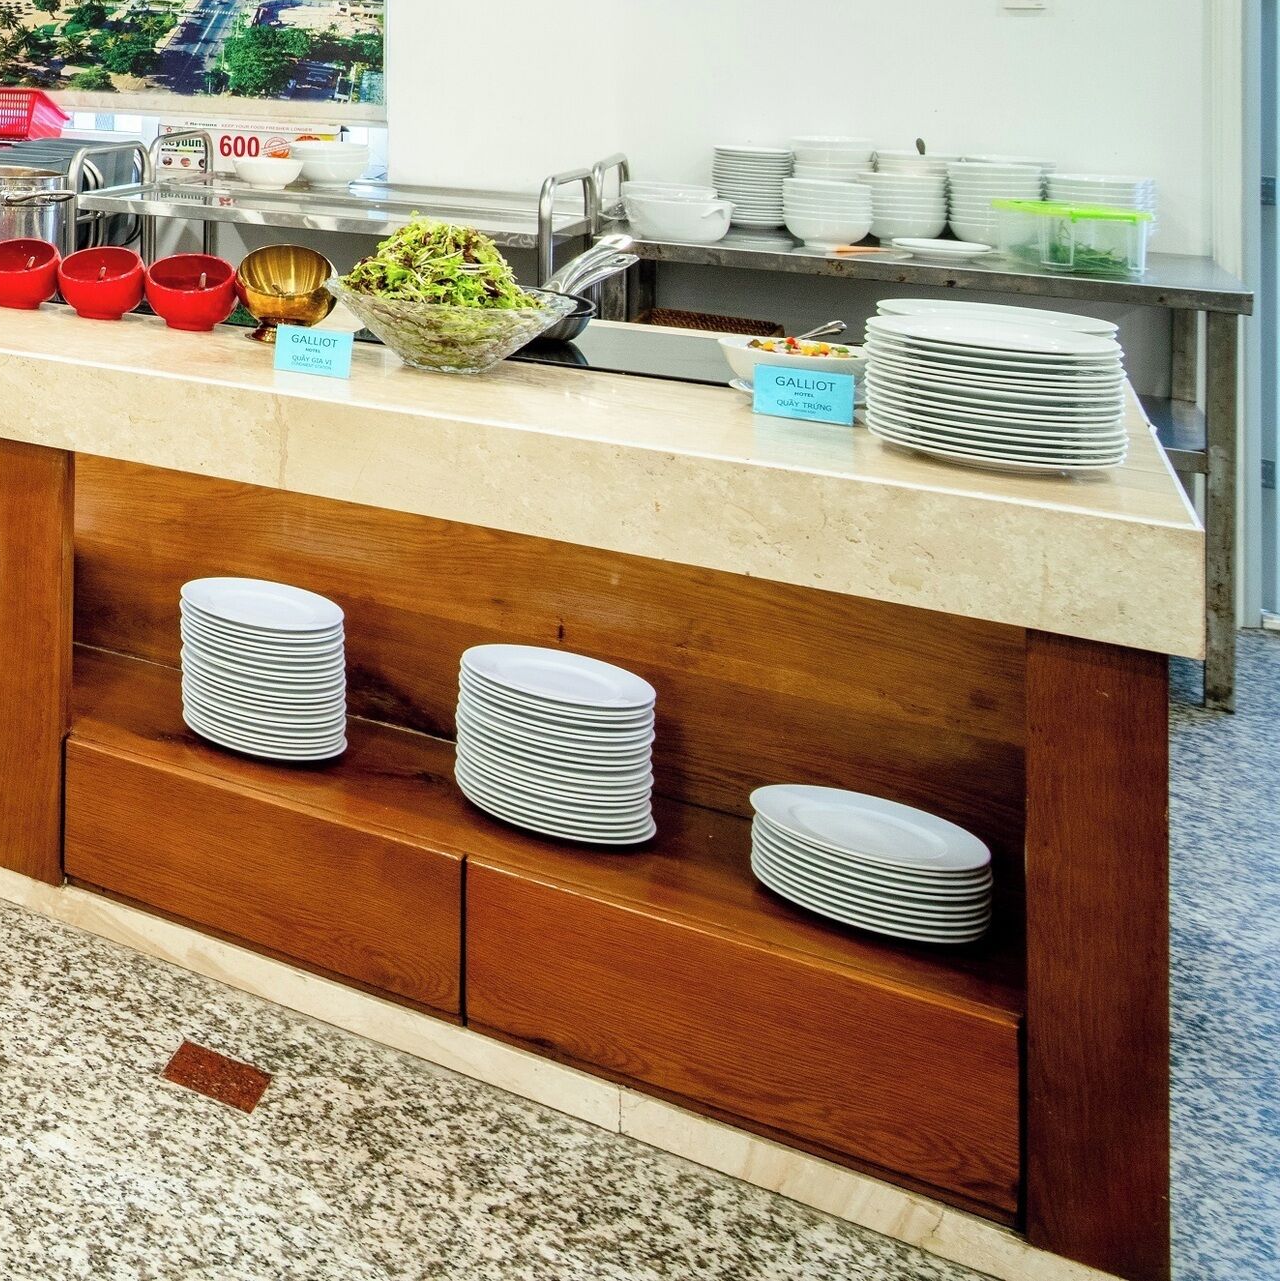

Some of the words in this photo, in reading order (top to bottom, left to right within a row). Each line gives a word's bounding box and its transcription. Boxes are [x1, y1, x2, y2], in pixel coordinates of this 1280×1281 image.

[219, 135, 260, 157] 600
[291, 333, 338, 348] GALLIOT
[775, 376, 836, 392] GALLIOT
[802, 401, 832, 412] TRỨNG
